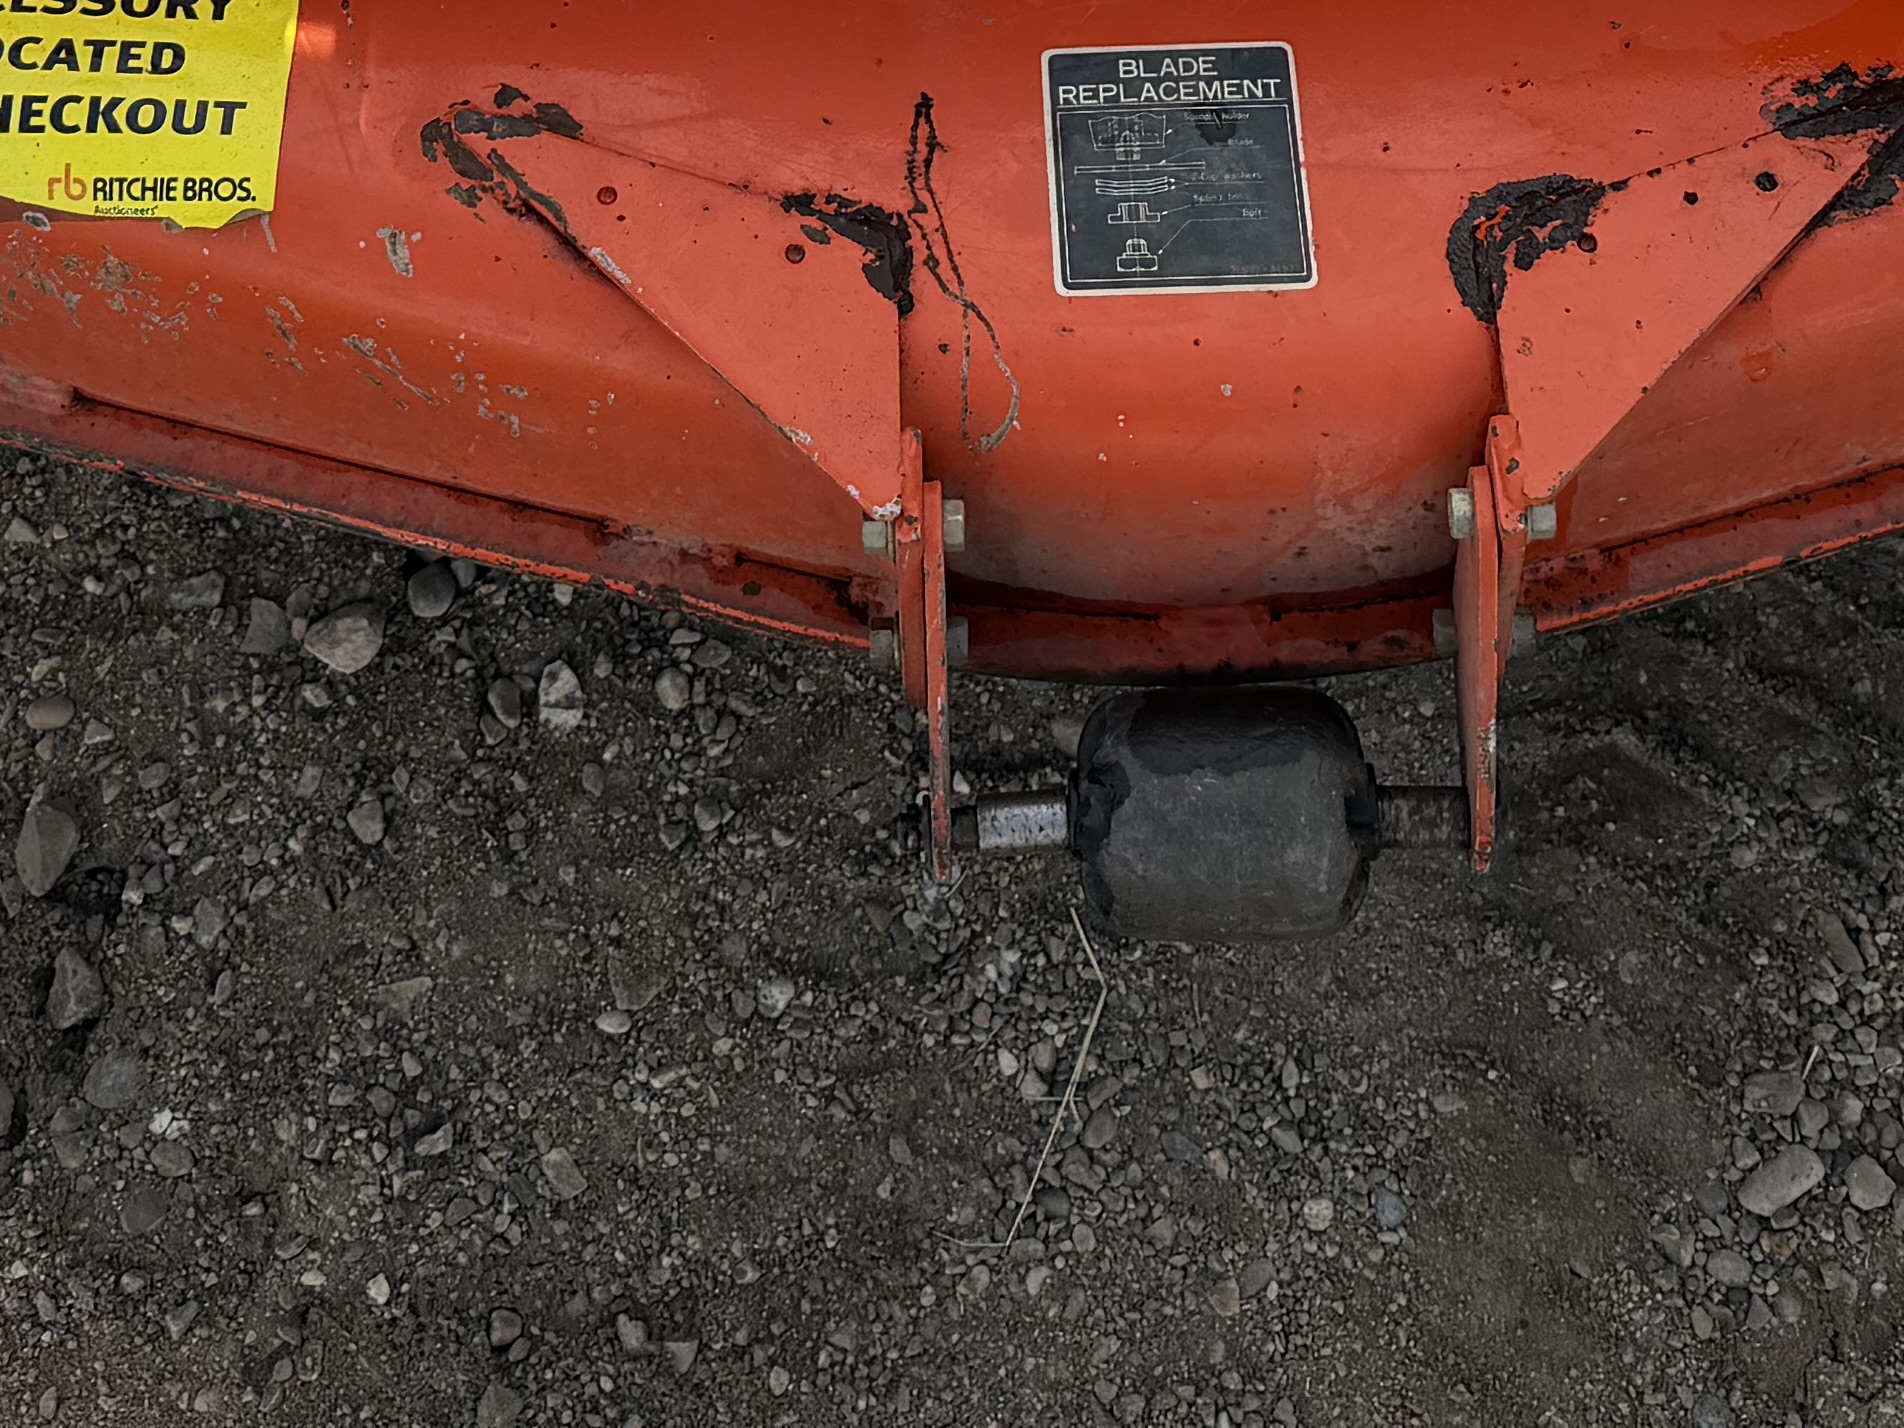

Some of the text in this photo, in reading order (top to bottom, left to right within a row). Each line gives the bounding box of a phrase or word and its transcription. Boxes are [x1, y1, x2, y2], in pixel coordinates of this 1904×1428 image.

[1118, 56, 1218, 78] BLADE
[1058, 79, 1281, 105] REPLACEMENT
[93, 177, 178, 201] RITCHIE
[183, 177, 256, 202] BROS.
